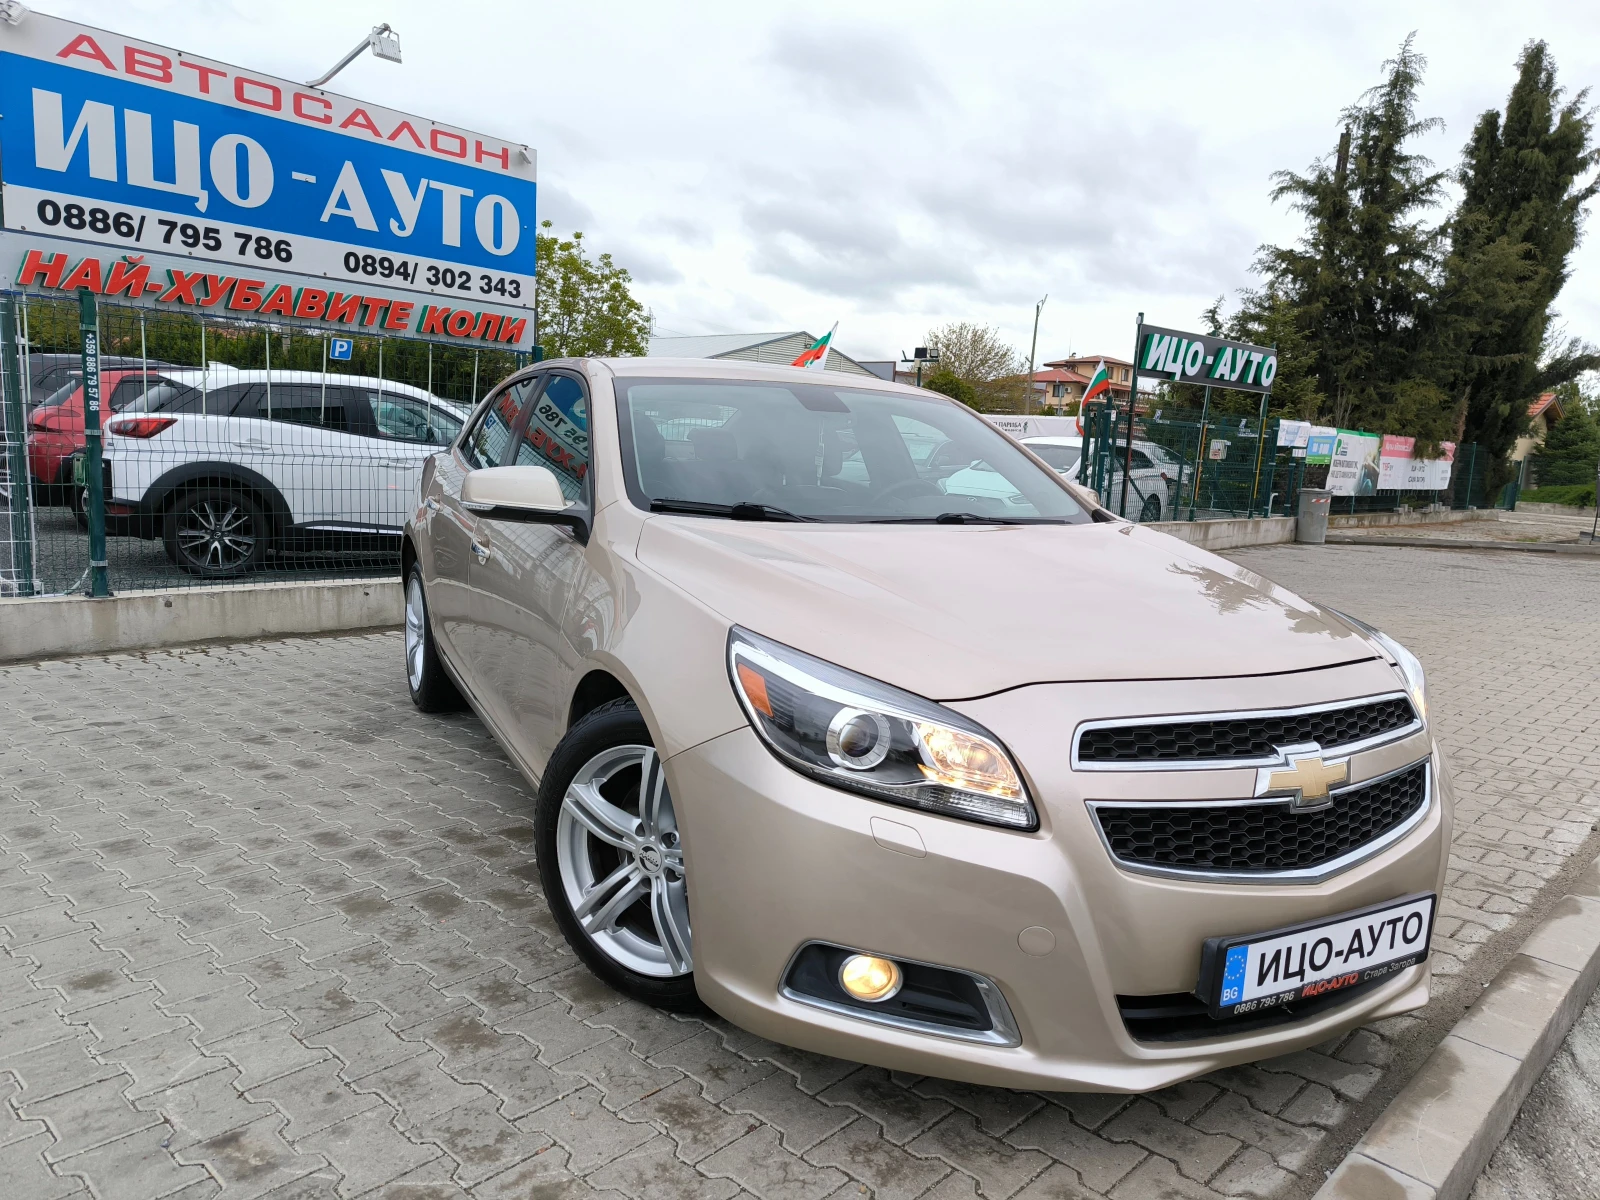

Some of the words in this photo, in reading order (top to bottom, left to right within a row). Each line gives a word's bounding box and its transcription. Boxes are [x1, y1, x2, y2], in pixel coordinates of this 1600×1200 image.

[56, 34, 509, 170] АВТОСАЛОН
[37, 199, 146, 242] 0886/
[157, 218, 222, 252] 795
[234, 233, 293, 263] 786
[344, 251, 419, 284] 0894/
[425, 265, 473, 292] 302
[479, 275, 521, 299] 343
[17, 249, 414, 331] НАЙ-ХУБАВИТЕ
[420, 305, 527, 345] КОЛИ
[86, 333, 96, 354] +359
[86, 357, 96, 372] 886
[1143, 333, 1278, 387] ИЦО-АУТО
[87, 375, 97, 385] 79
[88, 388, 98, 398] 57
[89, 400, 99, 411] 86
[1256, 911, 1423, 987] ИЦО-АУТО
[1364, 966, 1388, 981] Стара
[1388, 957, 1416, 974] Загора
[1223, 987, 1238, 1001] BG
[1302, 972, 1359, 998] ИЦО-АУТО
[1234, 1000, 1258, 1015] 0886
[1259, 997, 1276, 1009] 795
[1278, 991, 1295, 1005] 786
